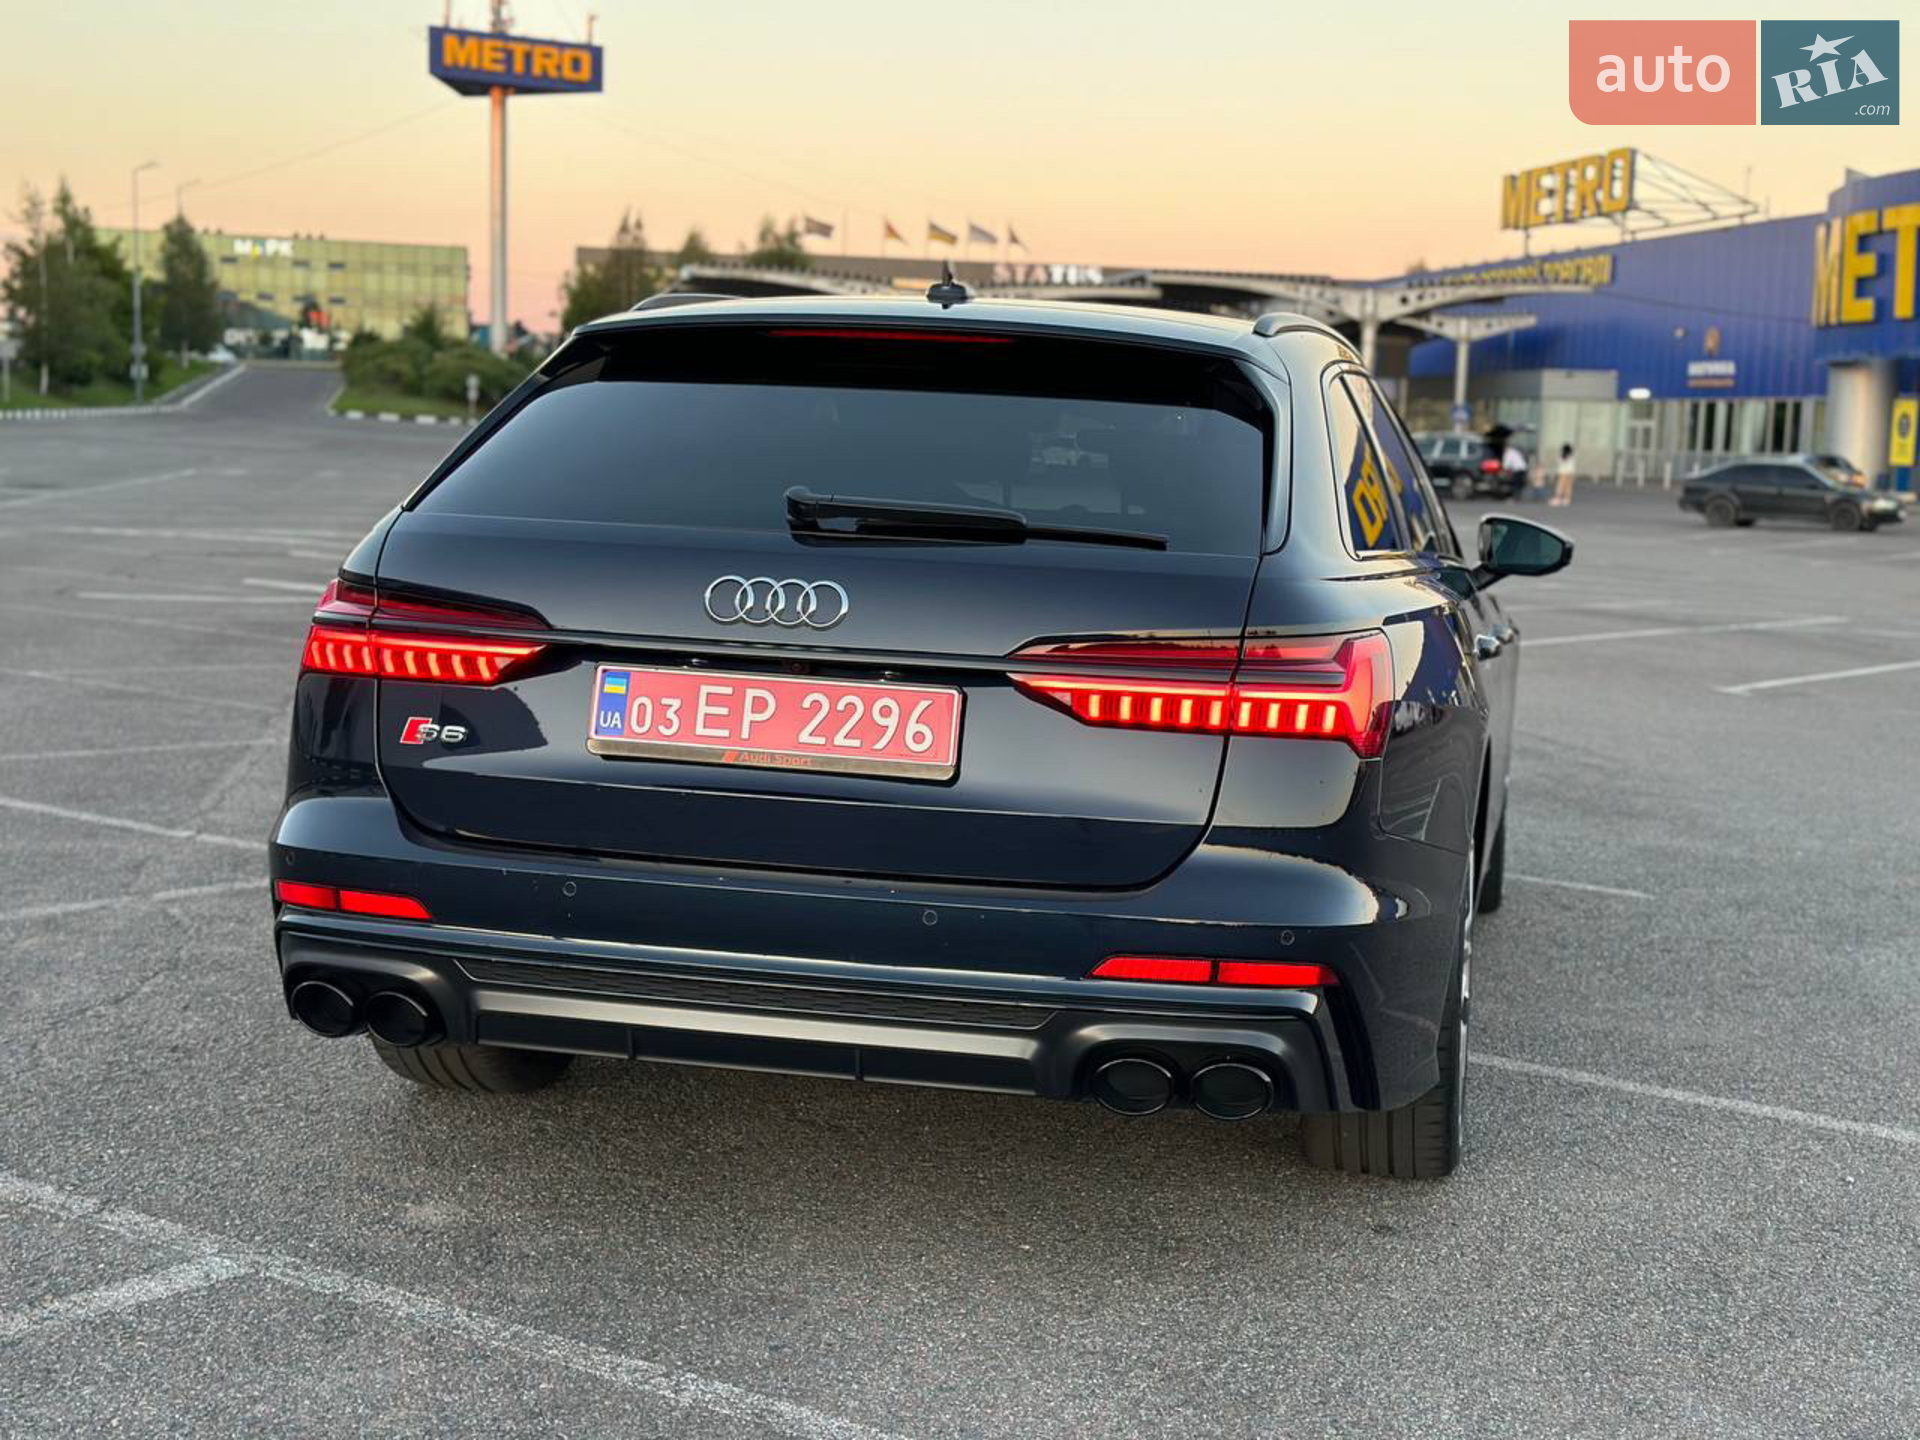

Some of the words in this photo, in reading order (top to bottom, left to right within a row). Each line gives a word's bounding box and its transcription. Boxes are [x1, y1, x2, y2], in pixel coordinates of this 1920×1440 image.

[442, 34, 593, 83] METRO
[1501, 147, 1636, 230] METRO
[415, 721, 469, 743] S6
[599, 710, 622, 729] UA
[630, 696, 682, 737] 03
[695, 684, 777, 740] EP
[798, 692, 934, 753] 2296
[740, 751, 771, 764] Audi
[773, 754, 813, 768] Sport
